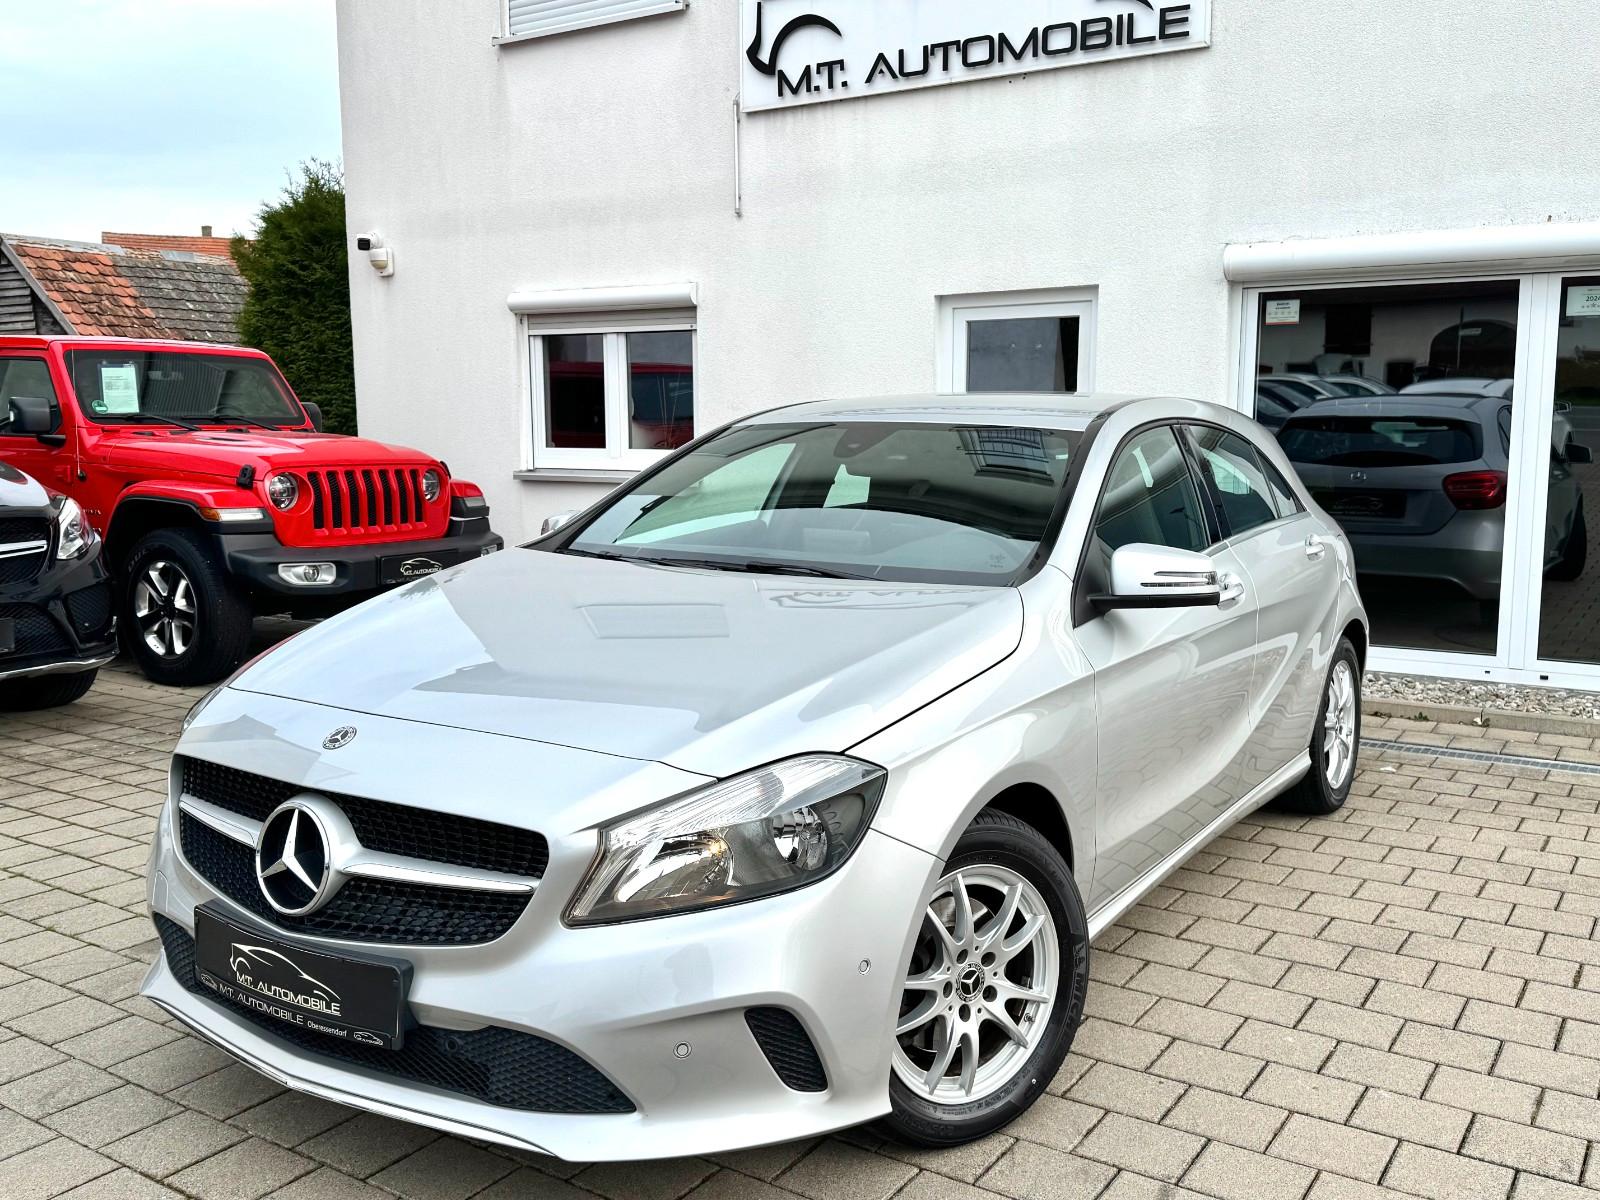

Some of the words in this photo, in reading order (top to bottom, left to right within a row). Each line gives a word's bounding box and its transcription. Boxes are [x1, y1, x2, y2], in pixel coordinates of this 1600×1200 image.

[776, 59, 848, 97] M.T.
[864, 4, 1191, 84] AUTOMOBILE
[237, 993, 304, 1024] AUTOMOBILE
[307, 1020, 348, 1038] Oberessendorf
[257, 981, 341, 1014] AUTOMOBILE
